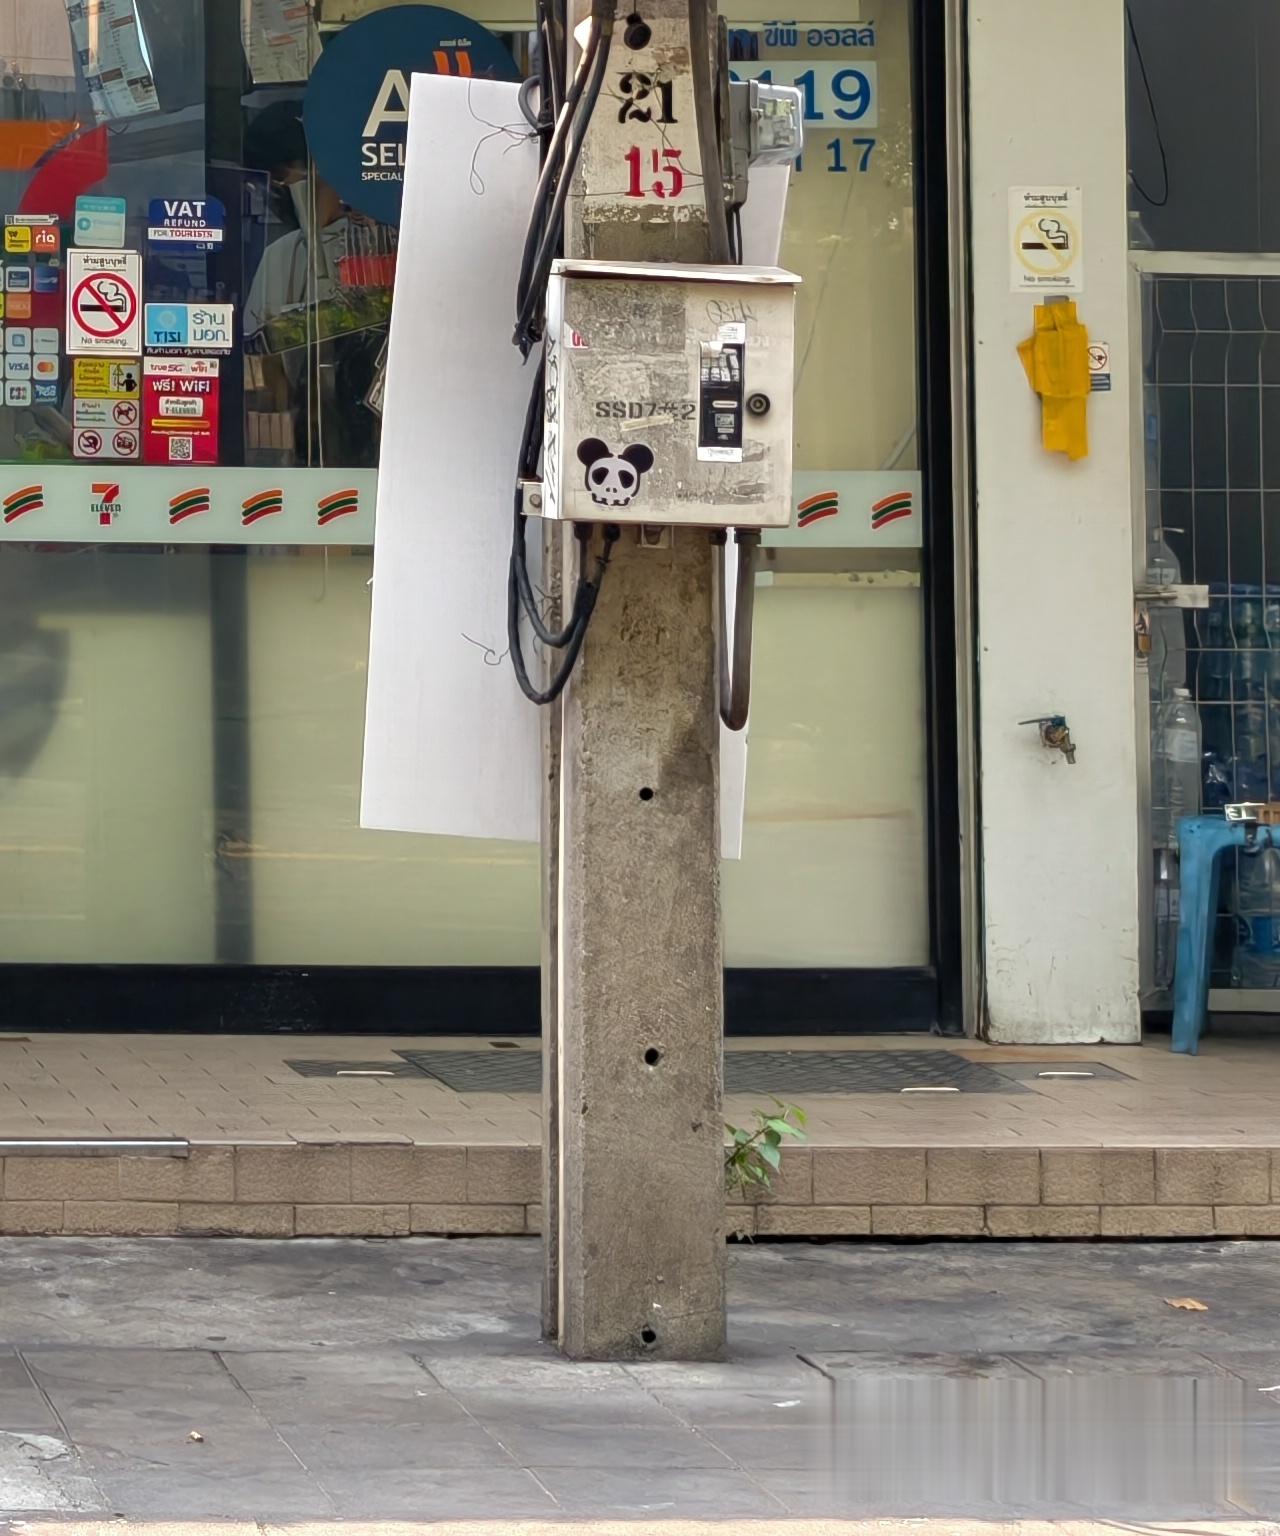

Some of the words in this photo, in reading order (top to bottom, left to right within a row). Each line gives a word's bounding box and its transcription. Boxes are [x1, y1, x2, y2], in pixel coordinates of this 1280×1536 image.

[762, 20, 798, 47] ซีพี
[807, 20, 875, 47] ออลล์
[618, 72, 679, 125] 21
[361, 172, 403, 182] SPECIAL
[623, 145, 684, 198] 15
[163, 200, 206, 217] VAT
[164, 218, 207, 228] REFUND
[35, 229, 56, 244] ria
[152, 230, 168, 238] FOR
[169, 229, 213, 239] TOURISTS
[192, 308, 225, 325] ร้าน
[81, 336, 92, 345] No
[154, 331, 181, 343] TISI
[8, 362, 29, 371] VISA
[179, 380, 210, 392] WiFi
